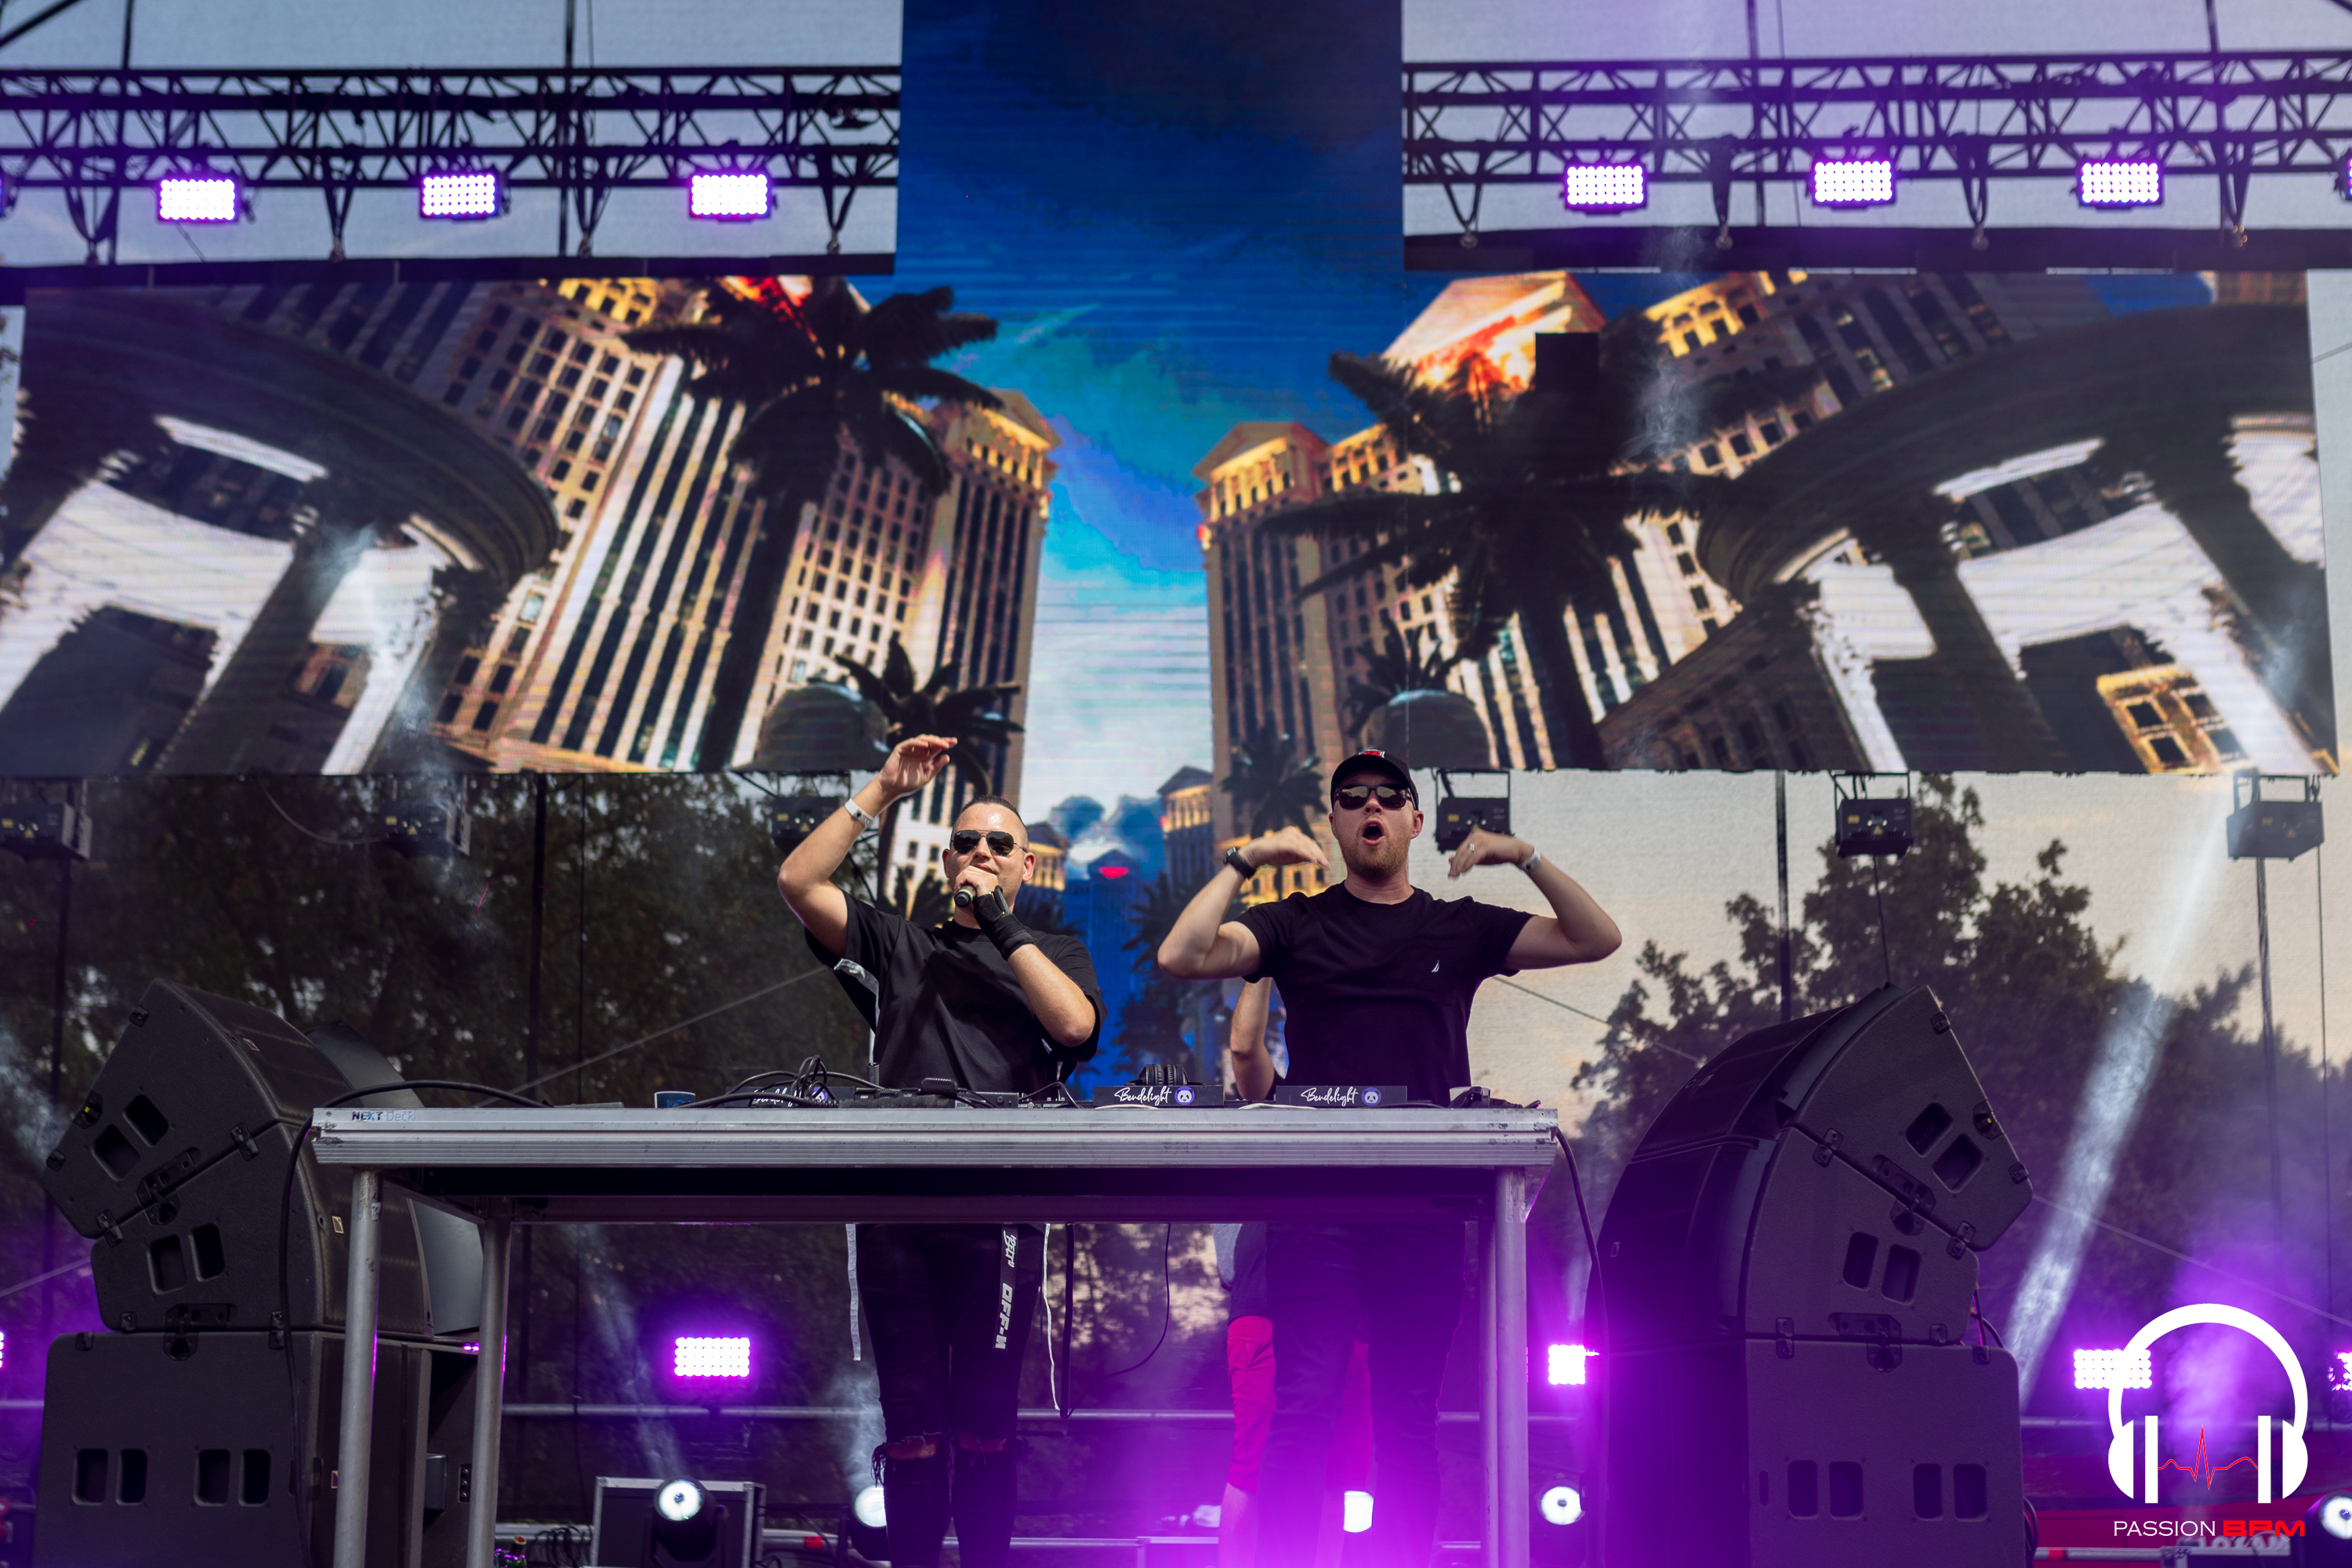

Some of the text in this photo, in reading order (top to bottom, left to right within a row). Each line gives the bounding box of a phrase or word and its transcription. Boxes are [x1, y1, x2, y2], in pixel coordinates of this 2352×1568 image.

[1114, 1086, 1172, 1105] Bendelight
[1301, 1086, 1359, 1106] Bendelight
[352, 1110, 415, 1121] NEXT Deck
